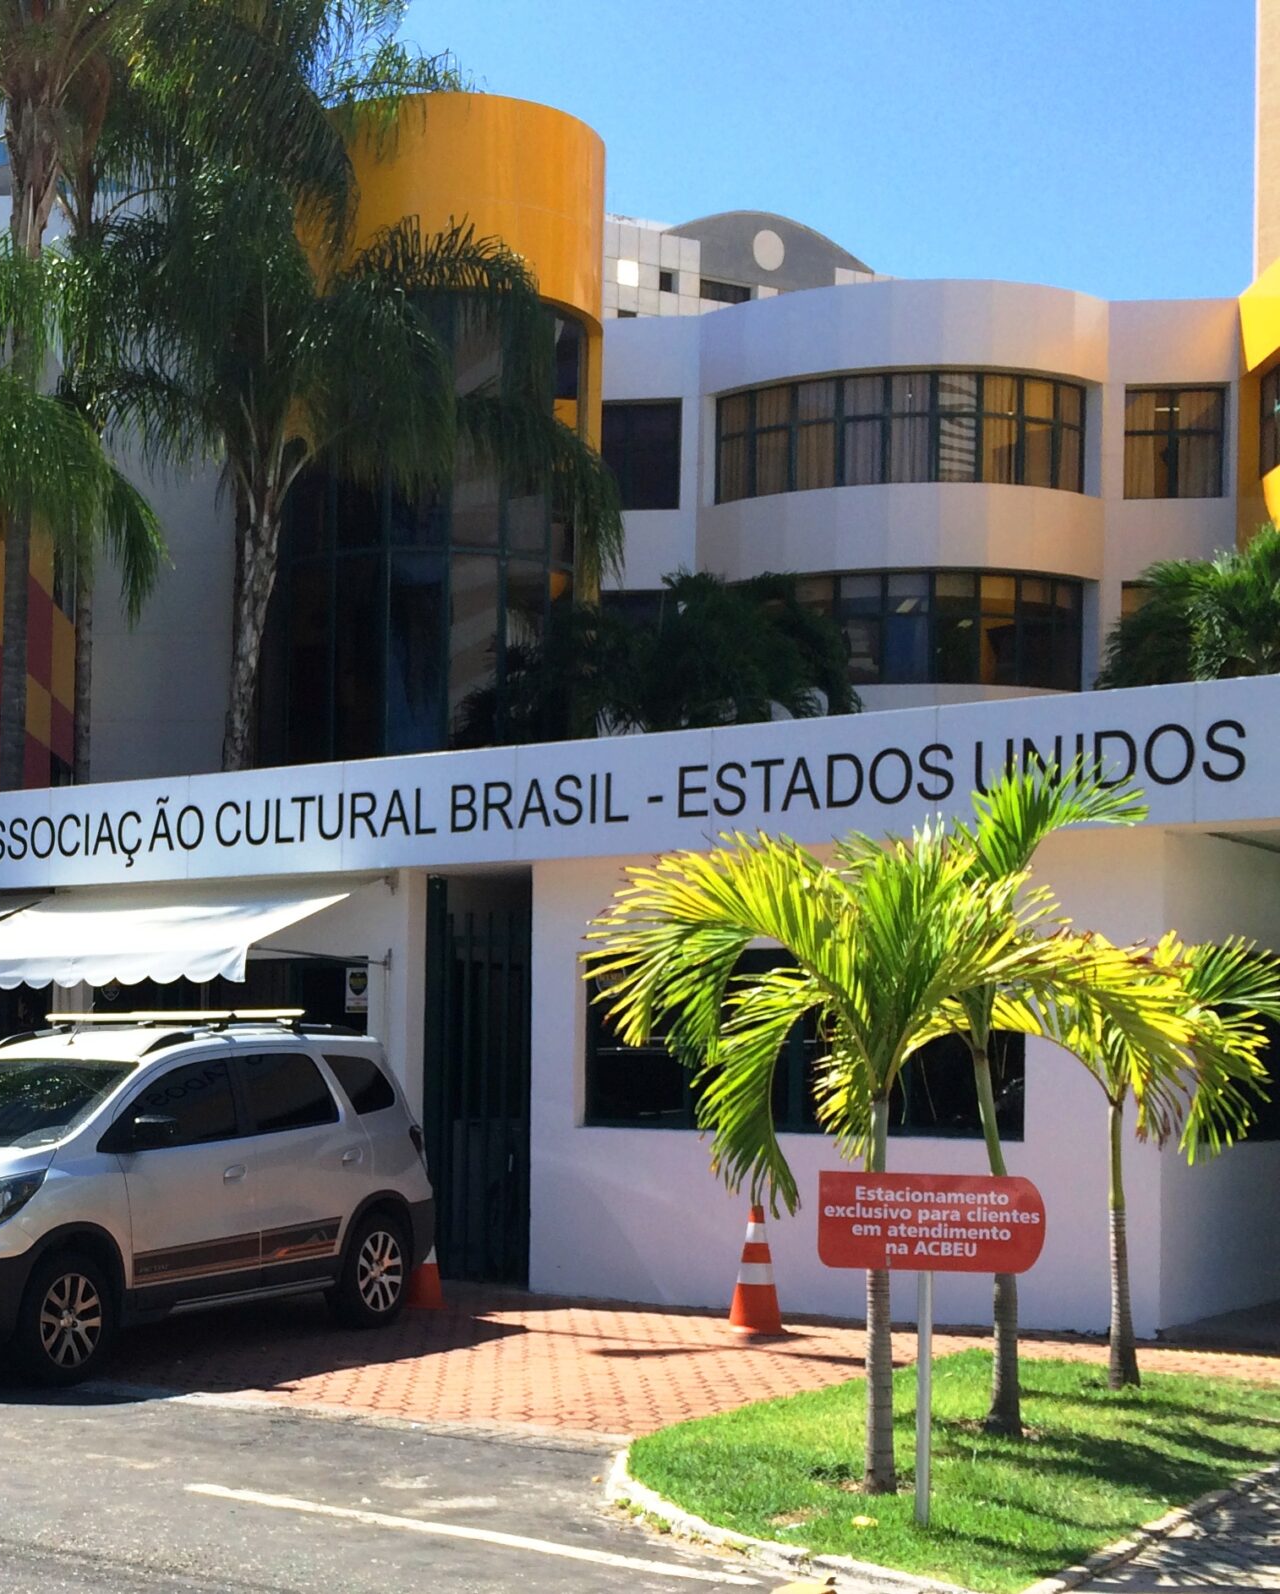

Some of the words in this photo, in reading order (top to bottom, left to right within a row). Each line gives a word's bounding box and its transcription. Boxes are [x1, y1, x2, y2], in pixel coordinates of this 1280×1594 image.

[216, 787, 437, 847] CULTURAL
[450, 772, 629, 833] BRASIL
[678, 743, 954, 818] ESTADOS
[975, 719, 1246, 798] UNIDOS
[855, 1185, 1009, 1206] Estacionamento
[824, 1203, 912, 1220] exclusivo
[918, 1209, 961, 1223] para
[966, 1207, 1040, 1224] clientes
[852, 1223, 881, 1236] em
[887, 1221, 1011, 1241] atendimento
[885, 1243, 908, 1255] na
[914, 1241, 977, 1257] ACBEU
